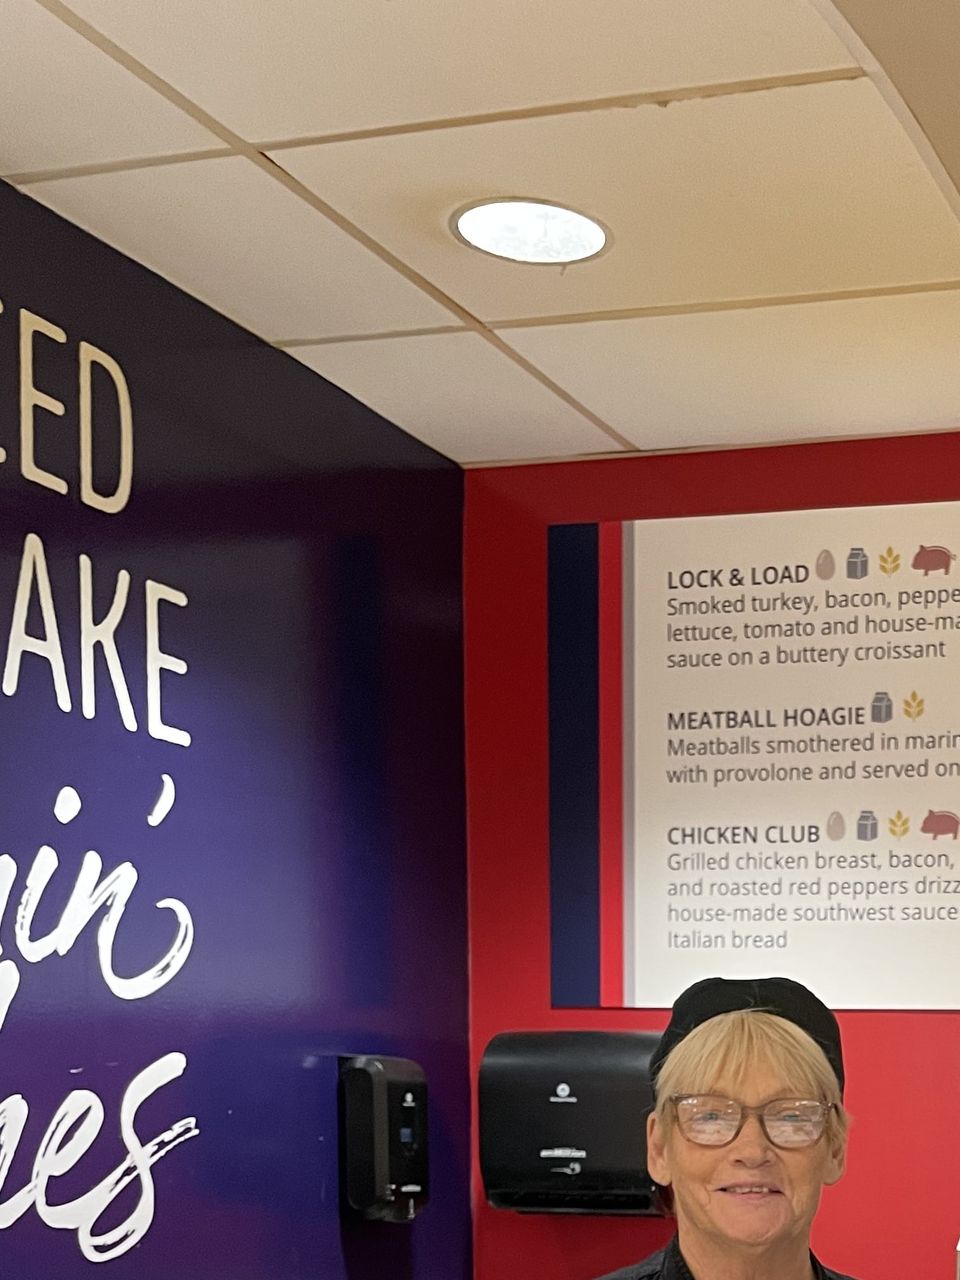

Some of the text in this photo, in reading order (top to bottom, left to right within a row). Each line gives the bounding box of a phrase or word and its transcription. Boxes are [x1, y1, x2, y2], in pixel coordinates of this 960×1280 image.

[0, 304, 134, 514] ED
[668, 565, 809, 589] LOCK & LOAD
[667, 594, 745, 616] Smoked
[751, 592, 818, 615] turkey,
[825, 590, 891, 608] bacon,
[667, 624, 737, 642] lettuce,
[744, 620, 815, 639] tomato
[821, 615, 858, 636] and
[667, 641, 946, 668] sauce on a buttery croissant
[668, 706, 865, 730] MEATBALL HOAGIE
[668, 736, 760, 756] Meatballs
[766, 732, 874, 754] smothered
[881, 733, 899, 750] in
[666, 765, 707, 783] with
[714, 763, 813, 787] provolone
[819, 761, 856, 780] and
[862, 758, 929, 779] served
[935, 762, 960, 777] on
[667, 825, 820, 845] CHICKEN CLUB
[668, 852, 729, 871] Grilled
[736, 852, 808, 870] chicken
[815, 850, 882, 871] breast,
[889, 850, 954, 870] bacon,
[0, 773, 194, 1000] in'
[668, 878, 703, 896] and
[710, 877, 782, 896] roasted
[789, 877, 821, 895] red
[828, 881, 908, 900] peppers
[668, 904, 787, 921] house-made
[793, 903, 895, 921] southwest
[901, 905, 959, 921] sauce
[667, 930, 787, 949] Italian bread
